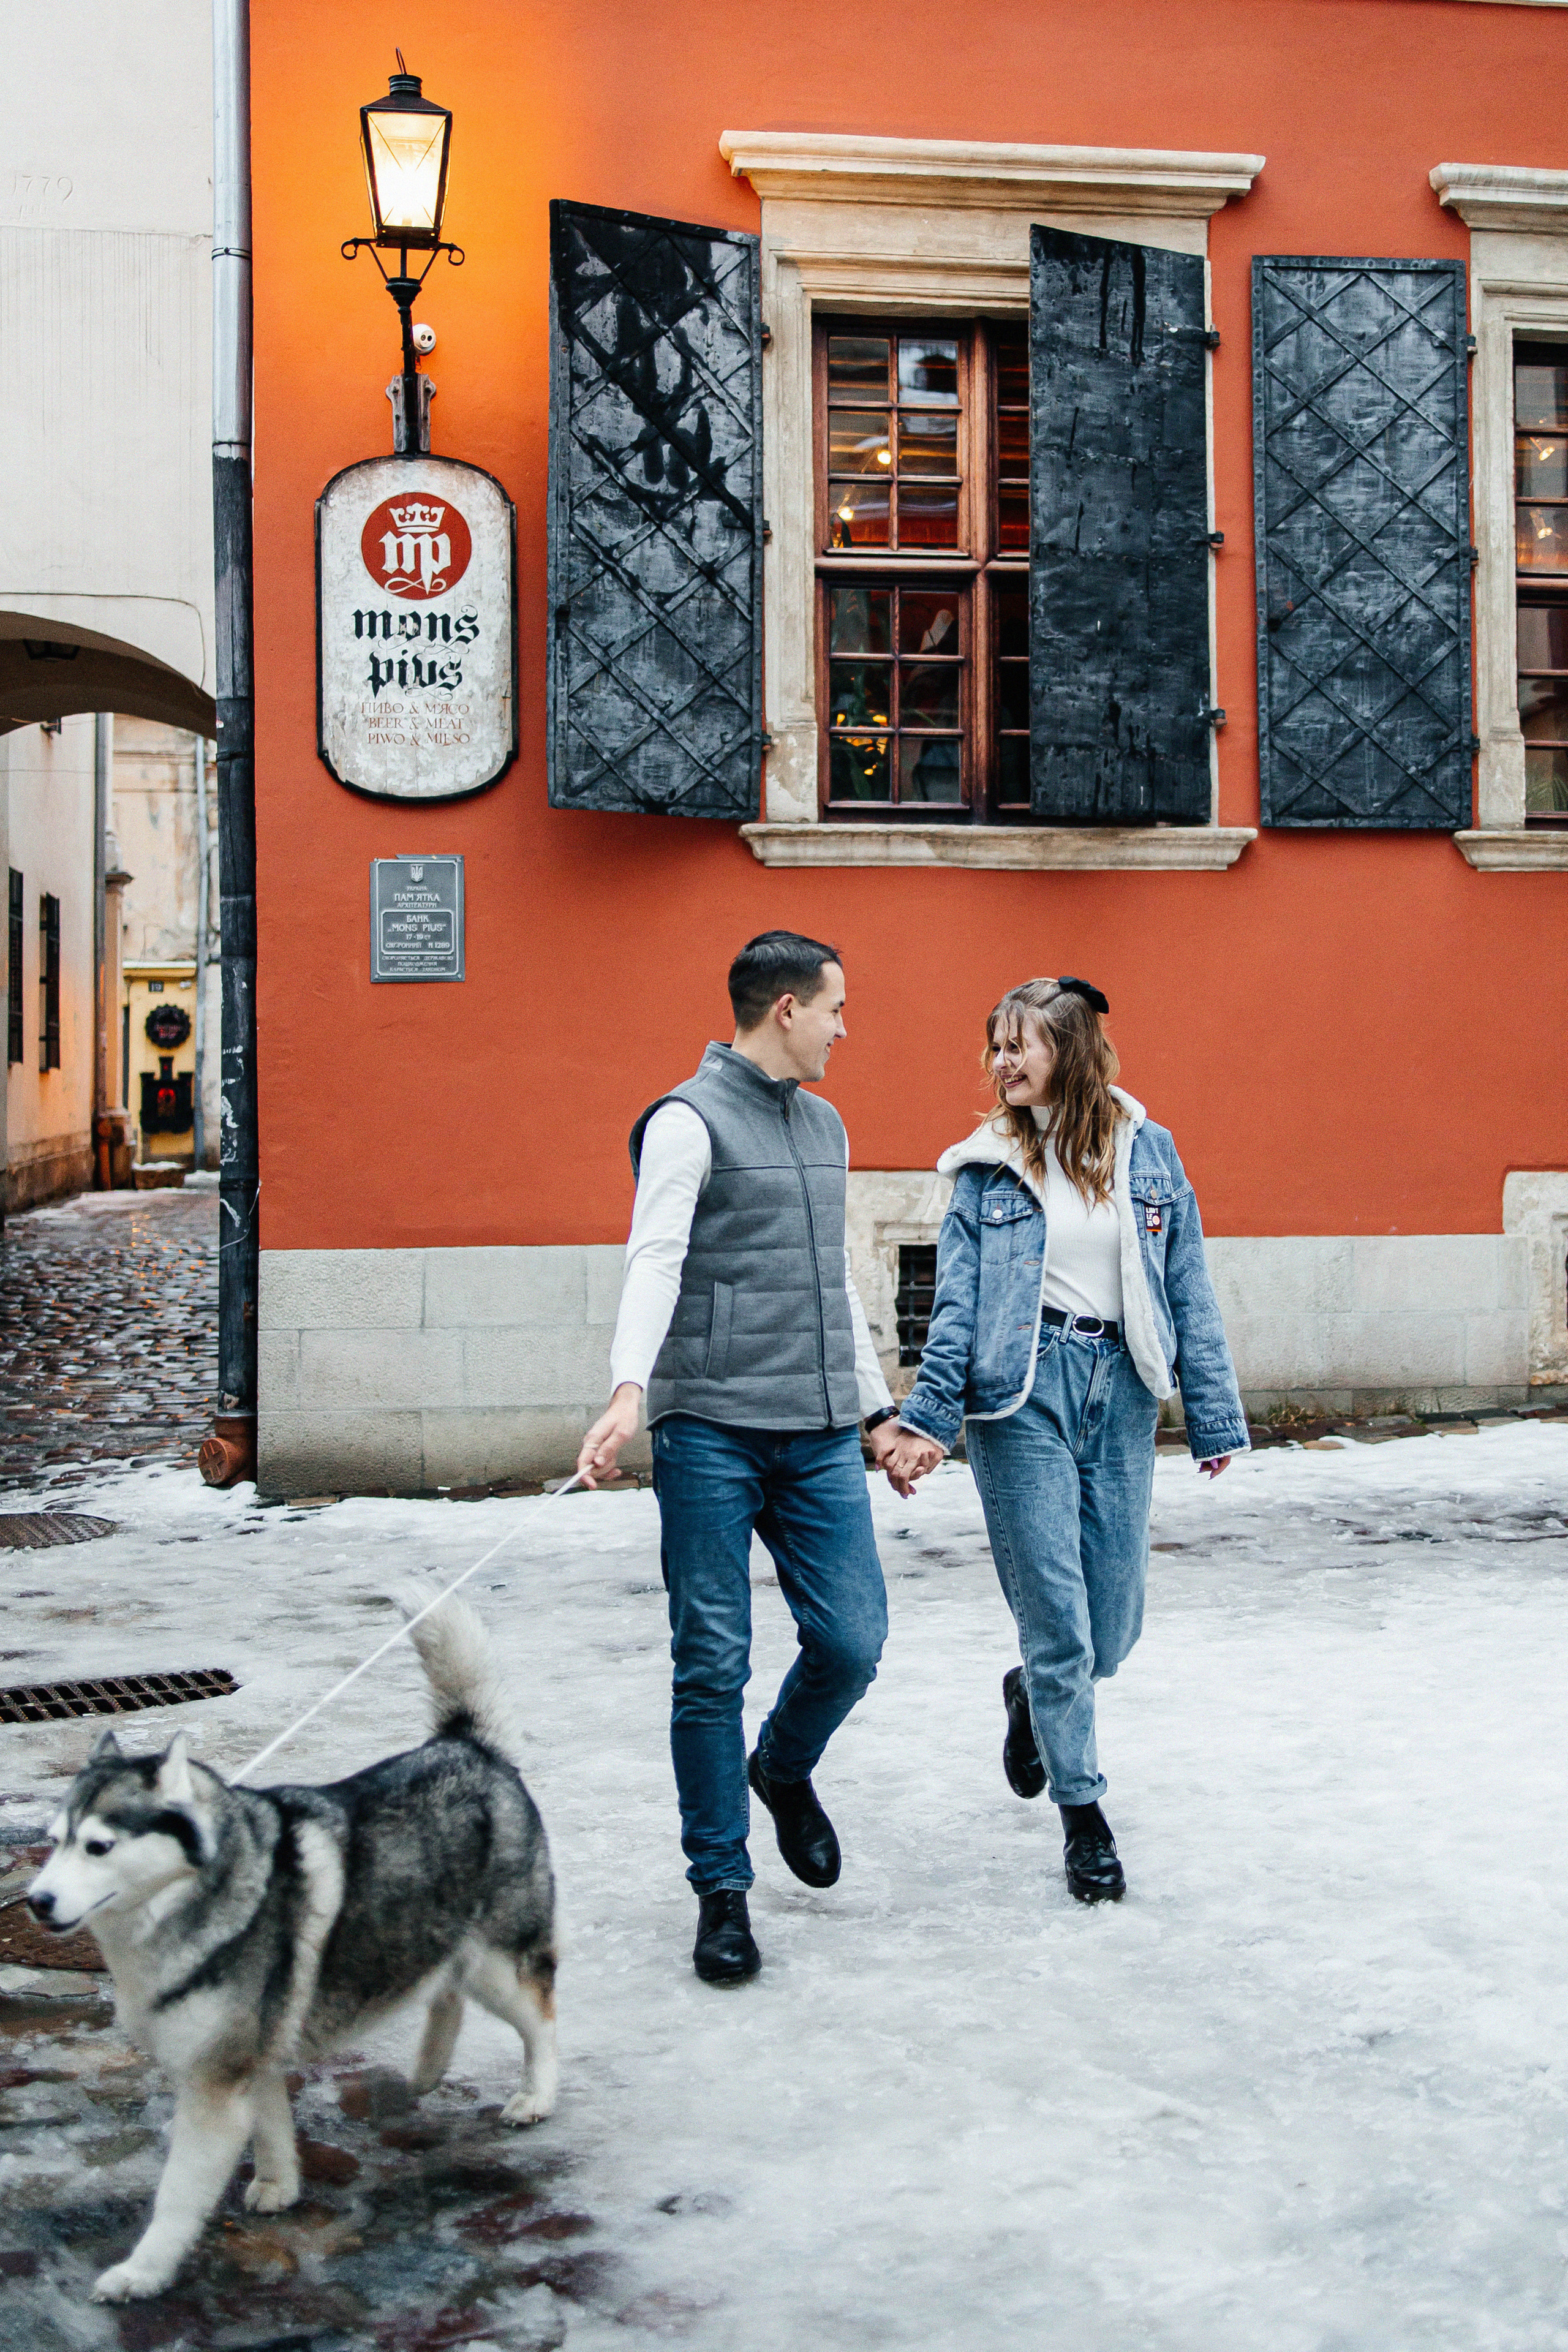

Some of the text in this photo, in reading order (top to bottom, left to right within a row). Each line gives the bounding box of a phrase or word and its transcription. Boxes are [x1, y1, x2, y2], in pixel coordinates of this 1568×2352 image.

[11, 174, 74, 205] 1779
[351, 604, 480, 645] mons
[361, 702, 404, 714] ПИВО
[409, 701, 420, 714] &
[369, 717, 464, 729] BEER & MEAT
[368, 733, 405, 745] PIWO
[410, 733, 420, 747] &
